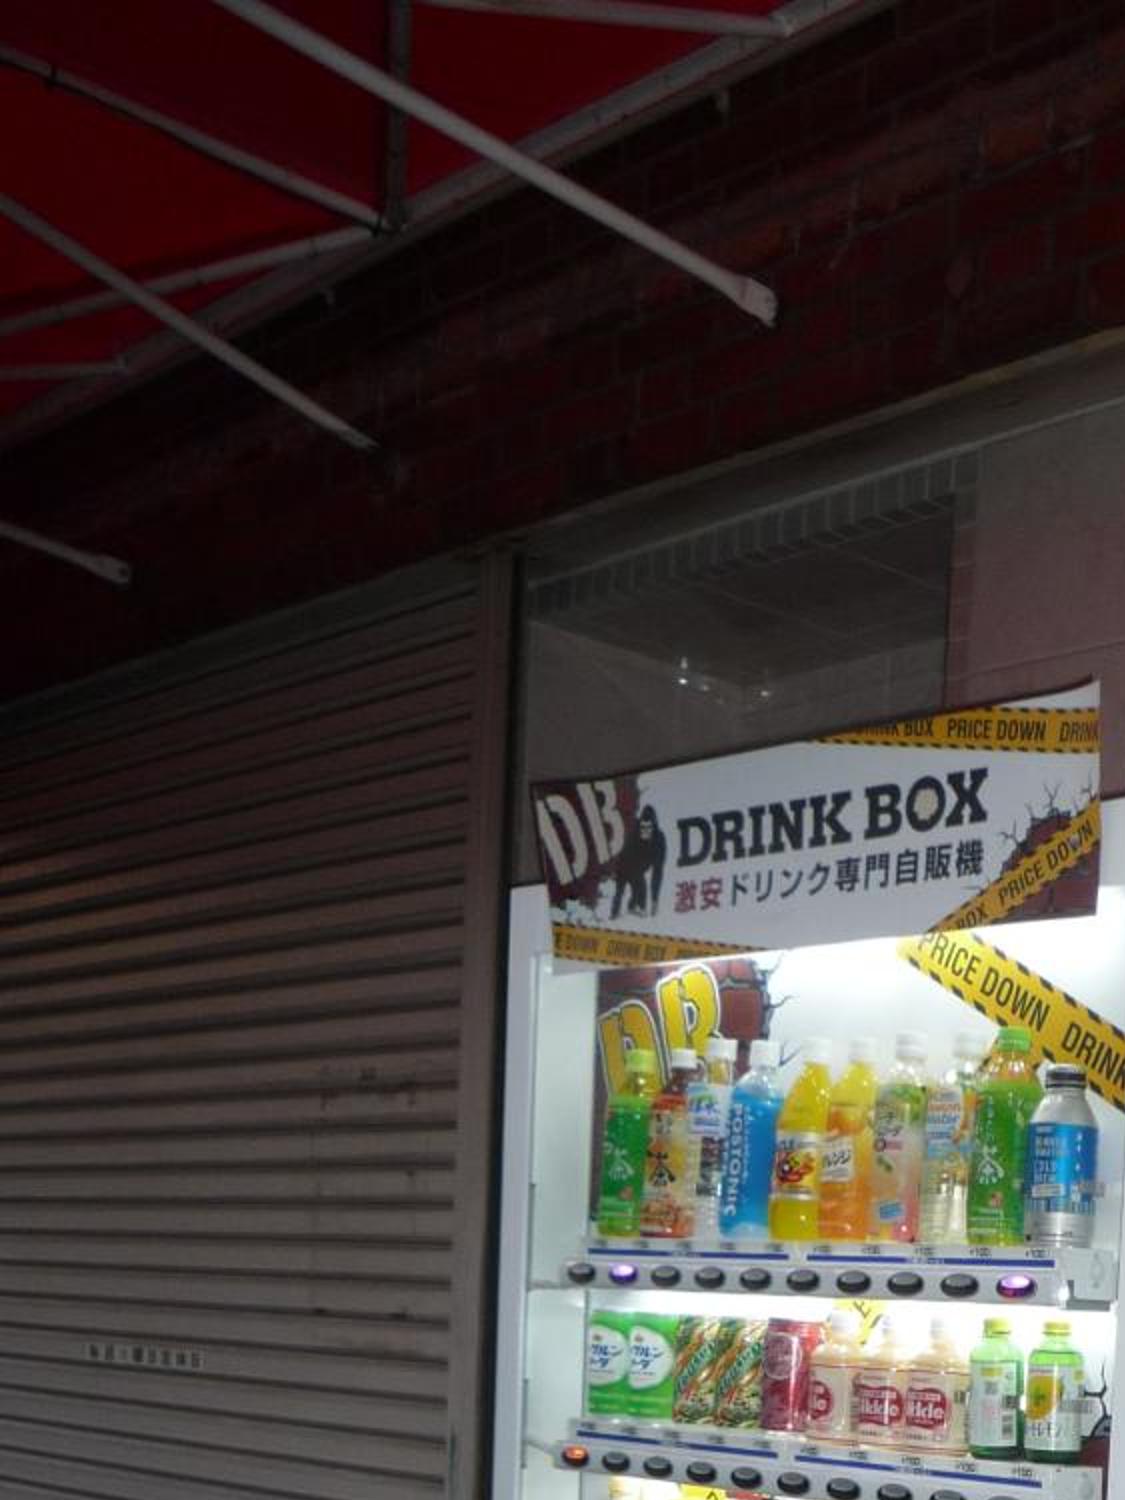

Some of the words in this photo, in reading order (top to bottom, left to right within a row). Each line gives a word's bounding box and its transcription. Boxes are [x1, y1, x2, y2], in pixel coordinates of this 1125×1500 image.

[947, 718, 992, 739] PRICE
[996, 718, 1046, 742] DOWN
[536, 779, 626, 887] DB
[676, 790, 852, 868] DRINK
[864, 767, 988, 840] BOX
[998, 862, 1043, 905] PRICE
[1047, 819, 1093, 868] DOWN
[674, 838, 985, 914] 激安ドリンク専門自販機
[917, 929, 982, 986] PRICE
[979, 966, 1051, 1033] DOWN
